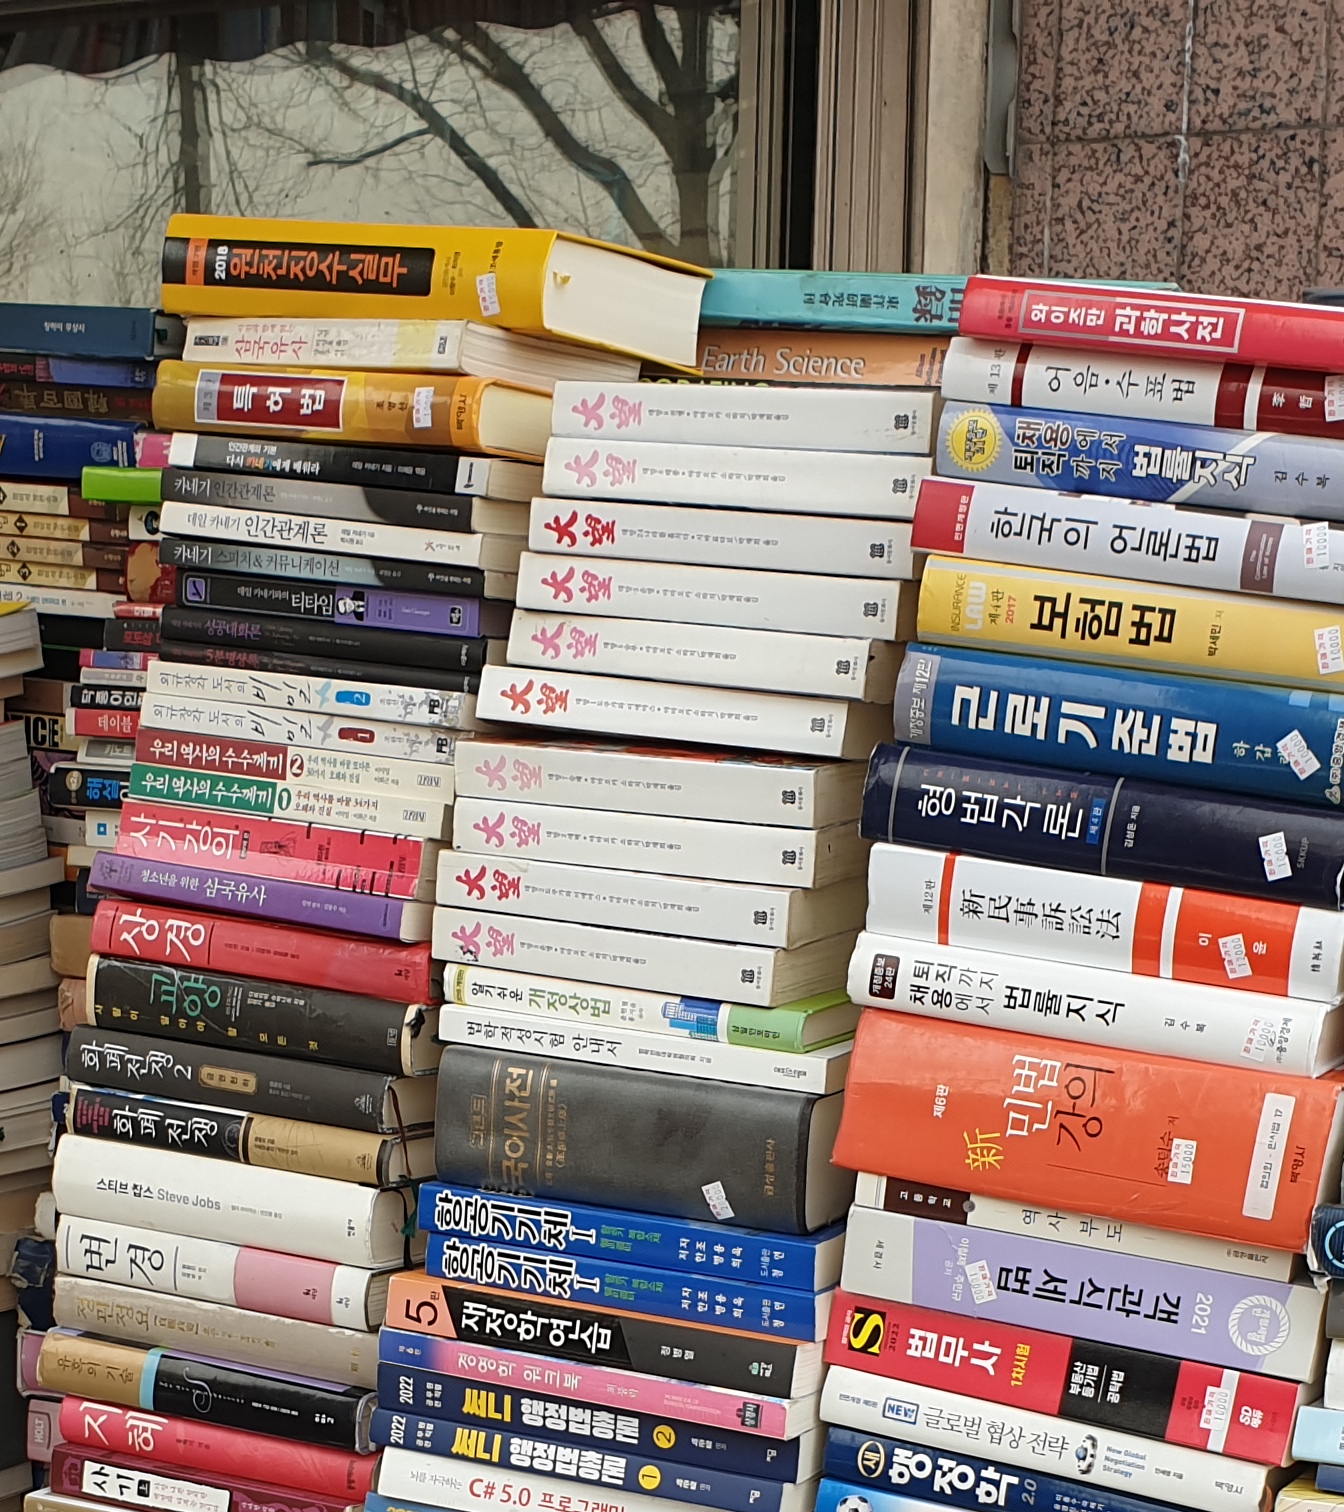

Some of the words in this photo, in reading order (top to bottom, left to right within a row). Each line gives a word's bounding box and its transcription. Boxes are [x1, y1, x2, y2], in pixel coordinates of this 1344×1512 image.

[229, 247, 409, 288] 원천징수실무
[1028, 300, 1106, 329] 와이즈만
[1112, 306, 1223, 344] 과학사전
[701, 345, 765, 375] Earth
[774, 349, 865, 378] Science
[1131, 442, 1258, 489] 법률지식
[989, 505, 1099, 551] 한국의
[1109, 523, 1221, 565] 언론법
[1030, 590, 1178, 647] 보험법
[950, 683, 1220, 765] 근로기준법
[148, 739, 178, 762] 우리
[180, 742, 222, 768] 역사의
[225, 746, 284, 774] 수수께끼
[918, 784, 1086, 840] 형법각론
[1003, 985, 1125, 1027] 법률지식
[434, 1192, 572, 1248] 항공기기체
[997, 1266, 1181, 1327] 객관식세법
[461, 1301, 611, 1352] 재정학연습
[907, 1328, 1002, 1375] 법무사
[462, 1388, 511, 1423] 써니
[520, 1398, 639, 1445] 행정법총론
[922, 1408, 983, 1444] 글로벌
[987, 1421, 1029, 1450] 협상
[1028, 1431, 1069, 1460] 전략
[469, 1479, 494, 1499] C#
[500, 1483, 531, 1507] 5.0
[888, 1445, 1019, 1506] 행정학
[1022, 1479, 1037, 1503] 2.0
